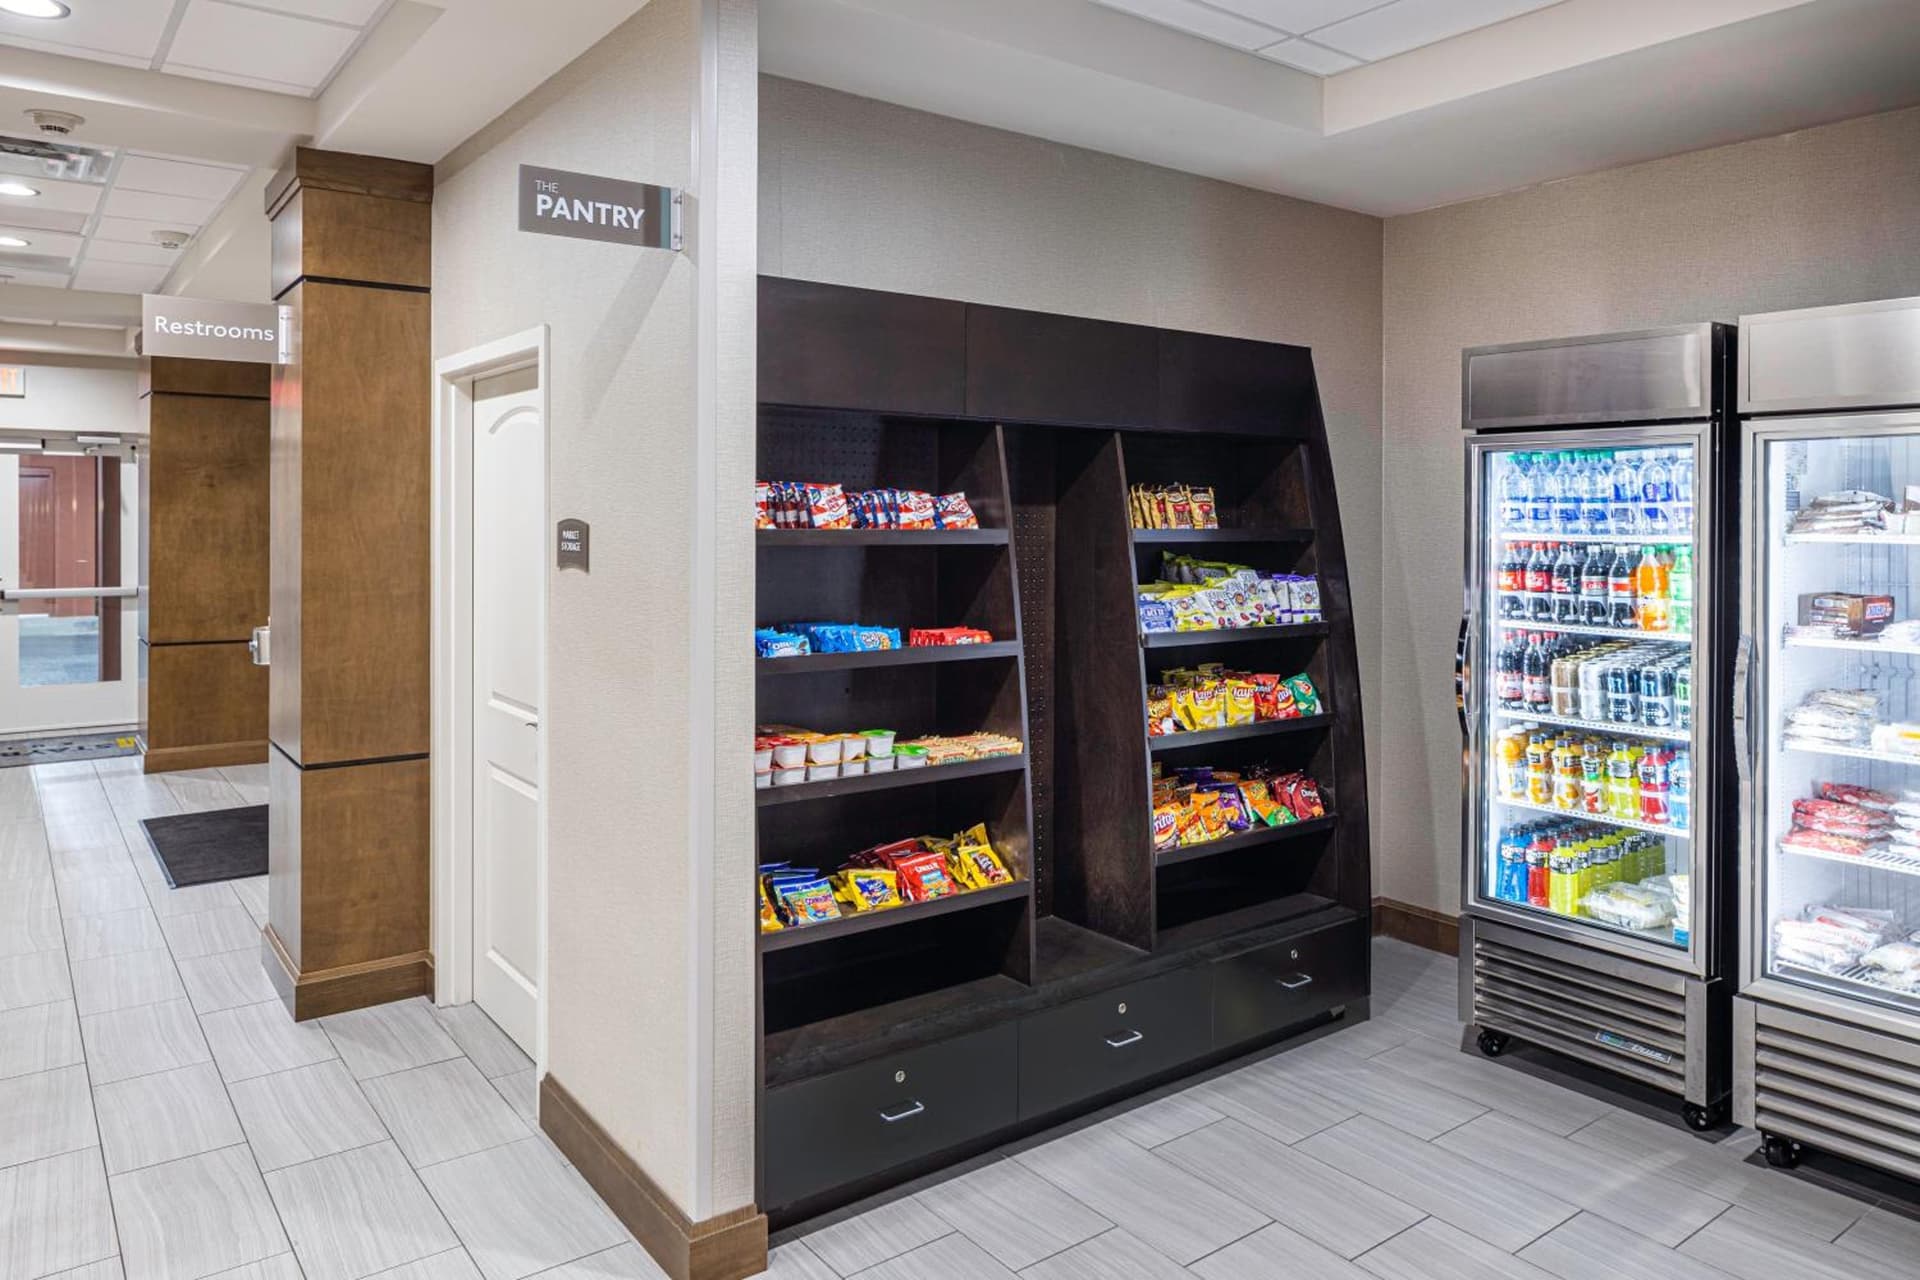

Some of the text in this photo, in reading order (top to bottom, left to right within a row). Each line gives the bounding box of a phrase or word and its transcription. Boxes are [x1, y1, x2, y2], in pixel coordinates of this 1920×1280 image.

[536, 180, 559, 193] THE
[536, 194, 645, 229] PANTRY
[154, 315, 275, 341] Restrooms
